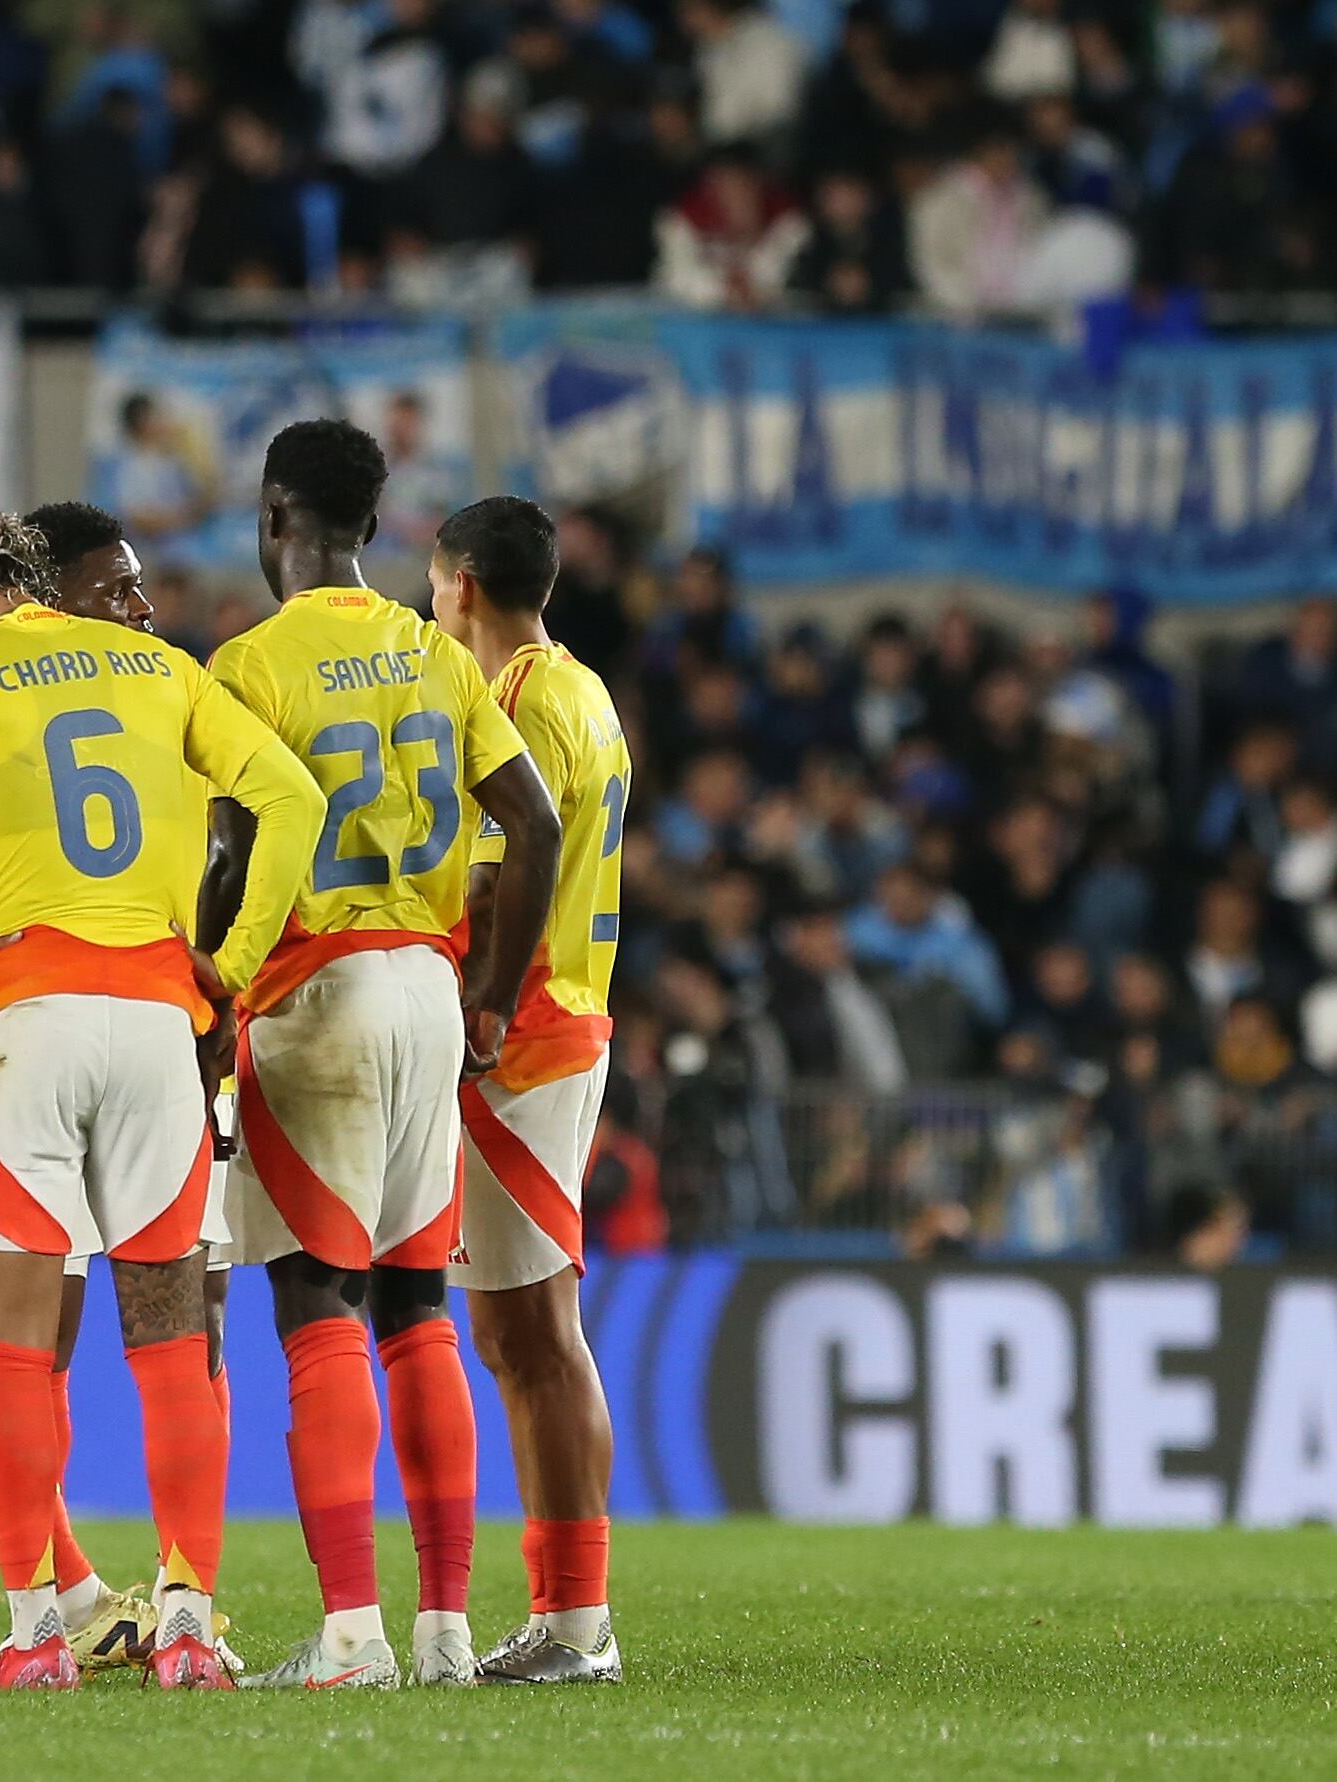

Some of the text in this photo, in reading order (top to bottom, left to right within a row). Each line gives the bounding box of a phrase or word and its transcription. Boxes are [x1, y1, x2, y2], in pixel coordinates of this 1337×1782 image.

[108, 650, 173, 678] RIOS
[43, 708, 143, 879] 6
[309, 709, 461, 894] 23
[758, 1271, 1337, 1525] CREA
